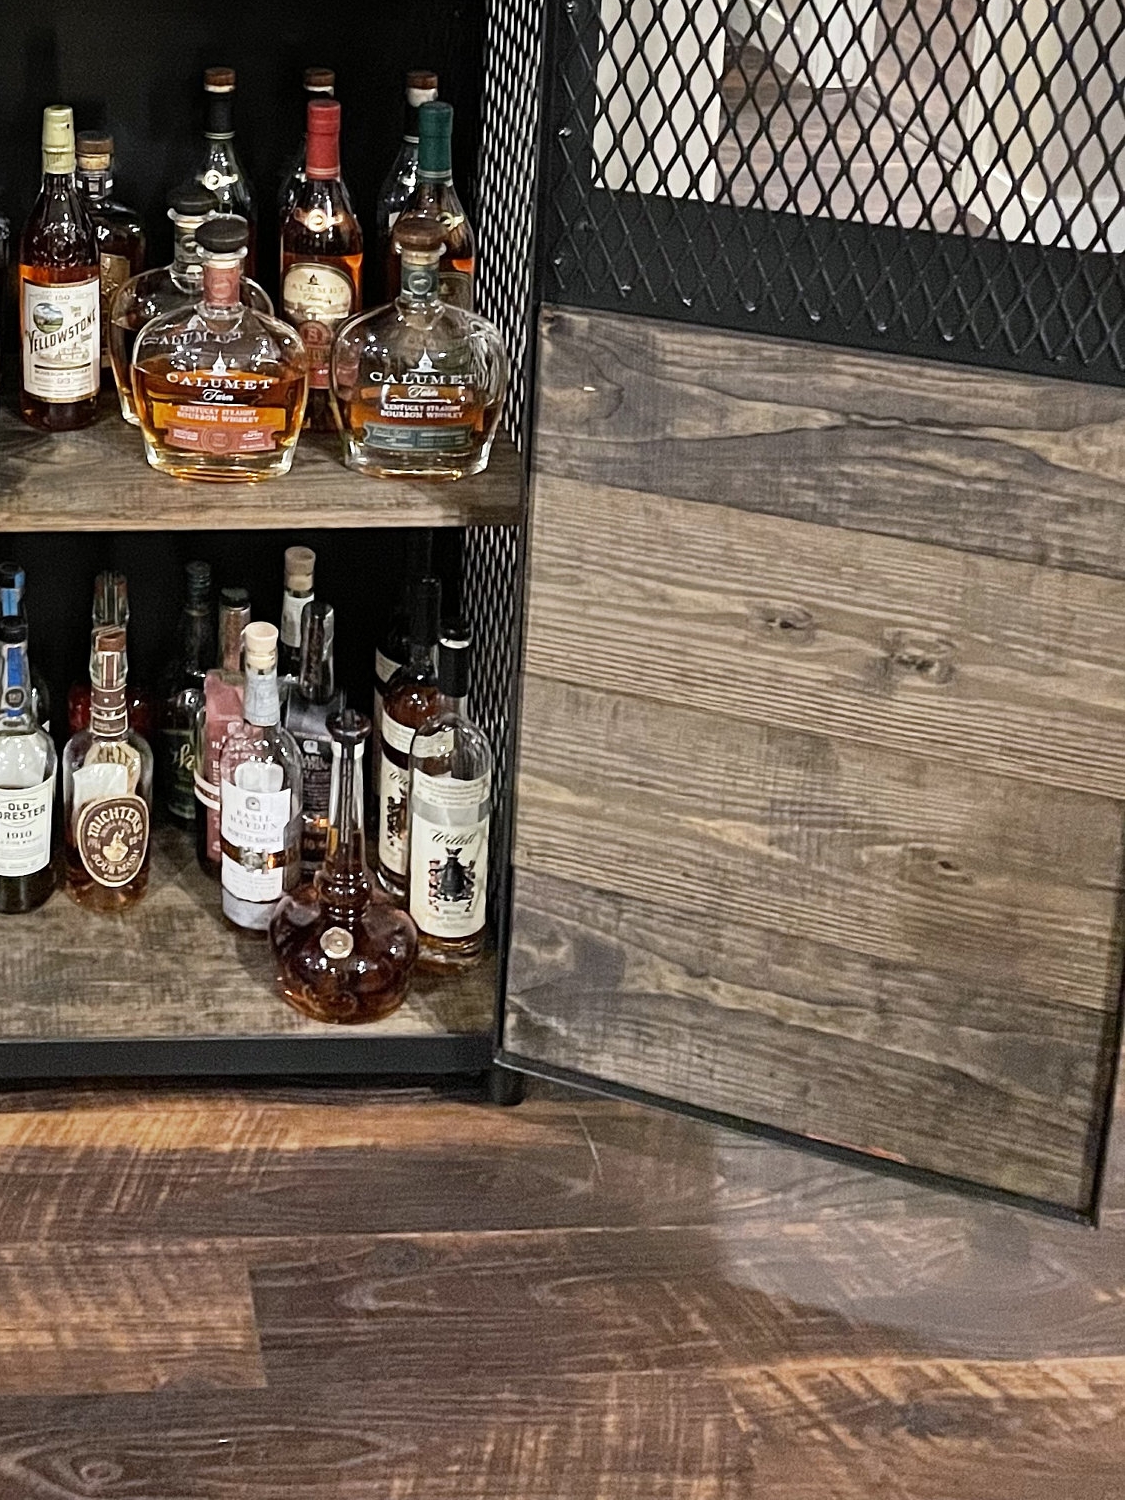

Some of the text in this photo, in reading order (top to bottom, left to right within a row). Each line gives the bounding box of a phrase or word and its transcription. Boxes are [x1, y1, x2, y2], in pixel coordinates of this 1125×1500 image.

[24, 308, 96, 355] YELLOWSTONE
[166, 372, 274, 390] CALUMET
[369, 371, 476, 386] CALUMET
[179, 405, 220, 415] KENTUCKY
[383, 403, 424, 411] KENTUCKY
[176, 411, 259, 423] BOURBON WHISKEY
[380, 409, 423, 419] BOURBON
[7, 802, 30, 811] OLD
